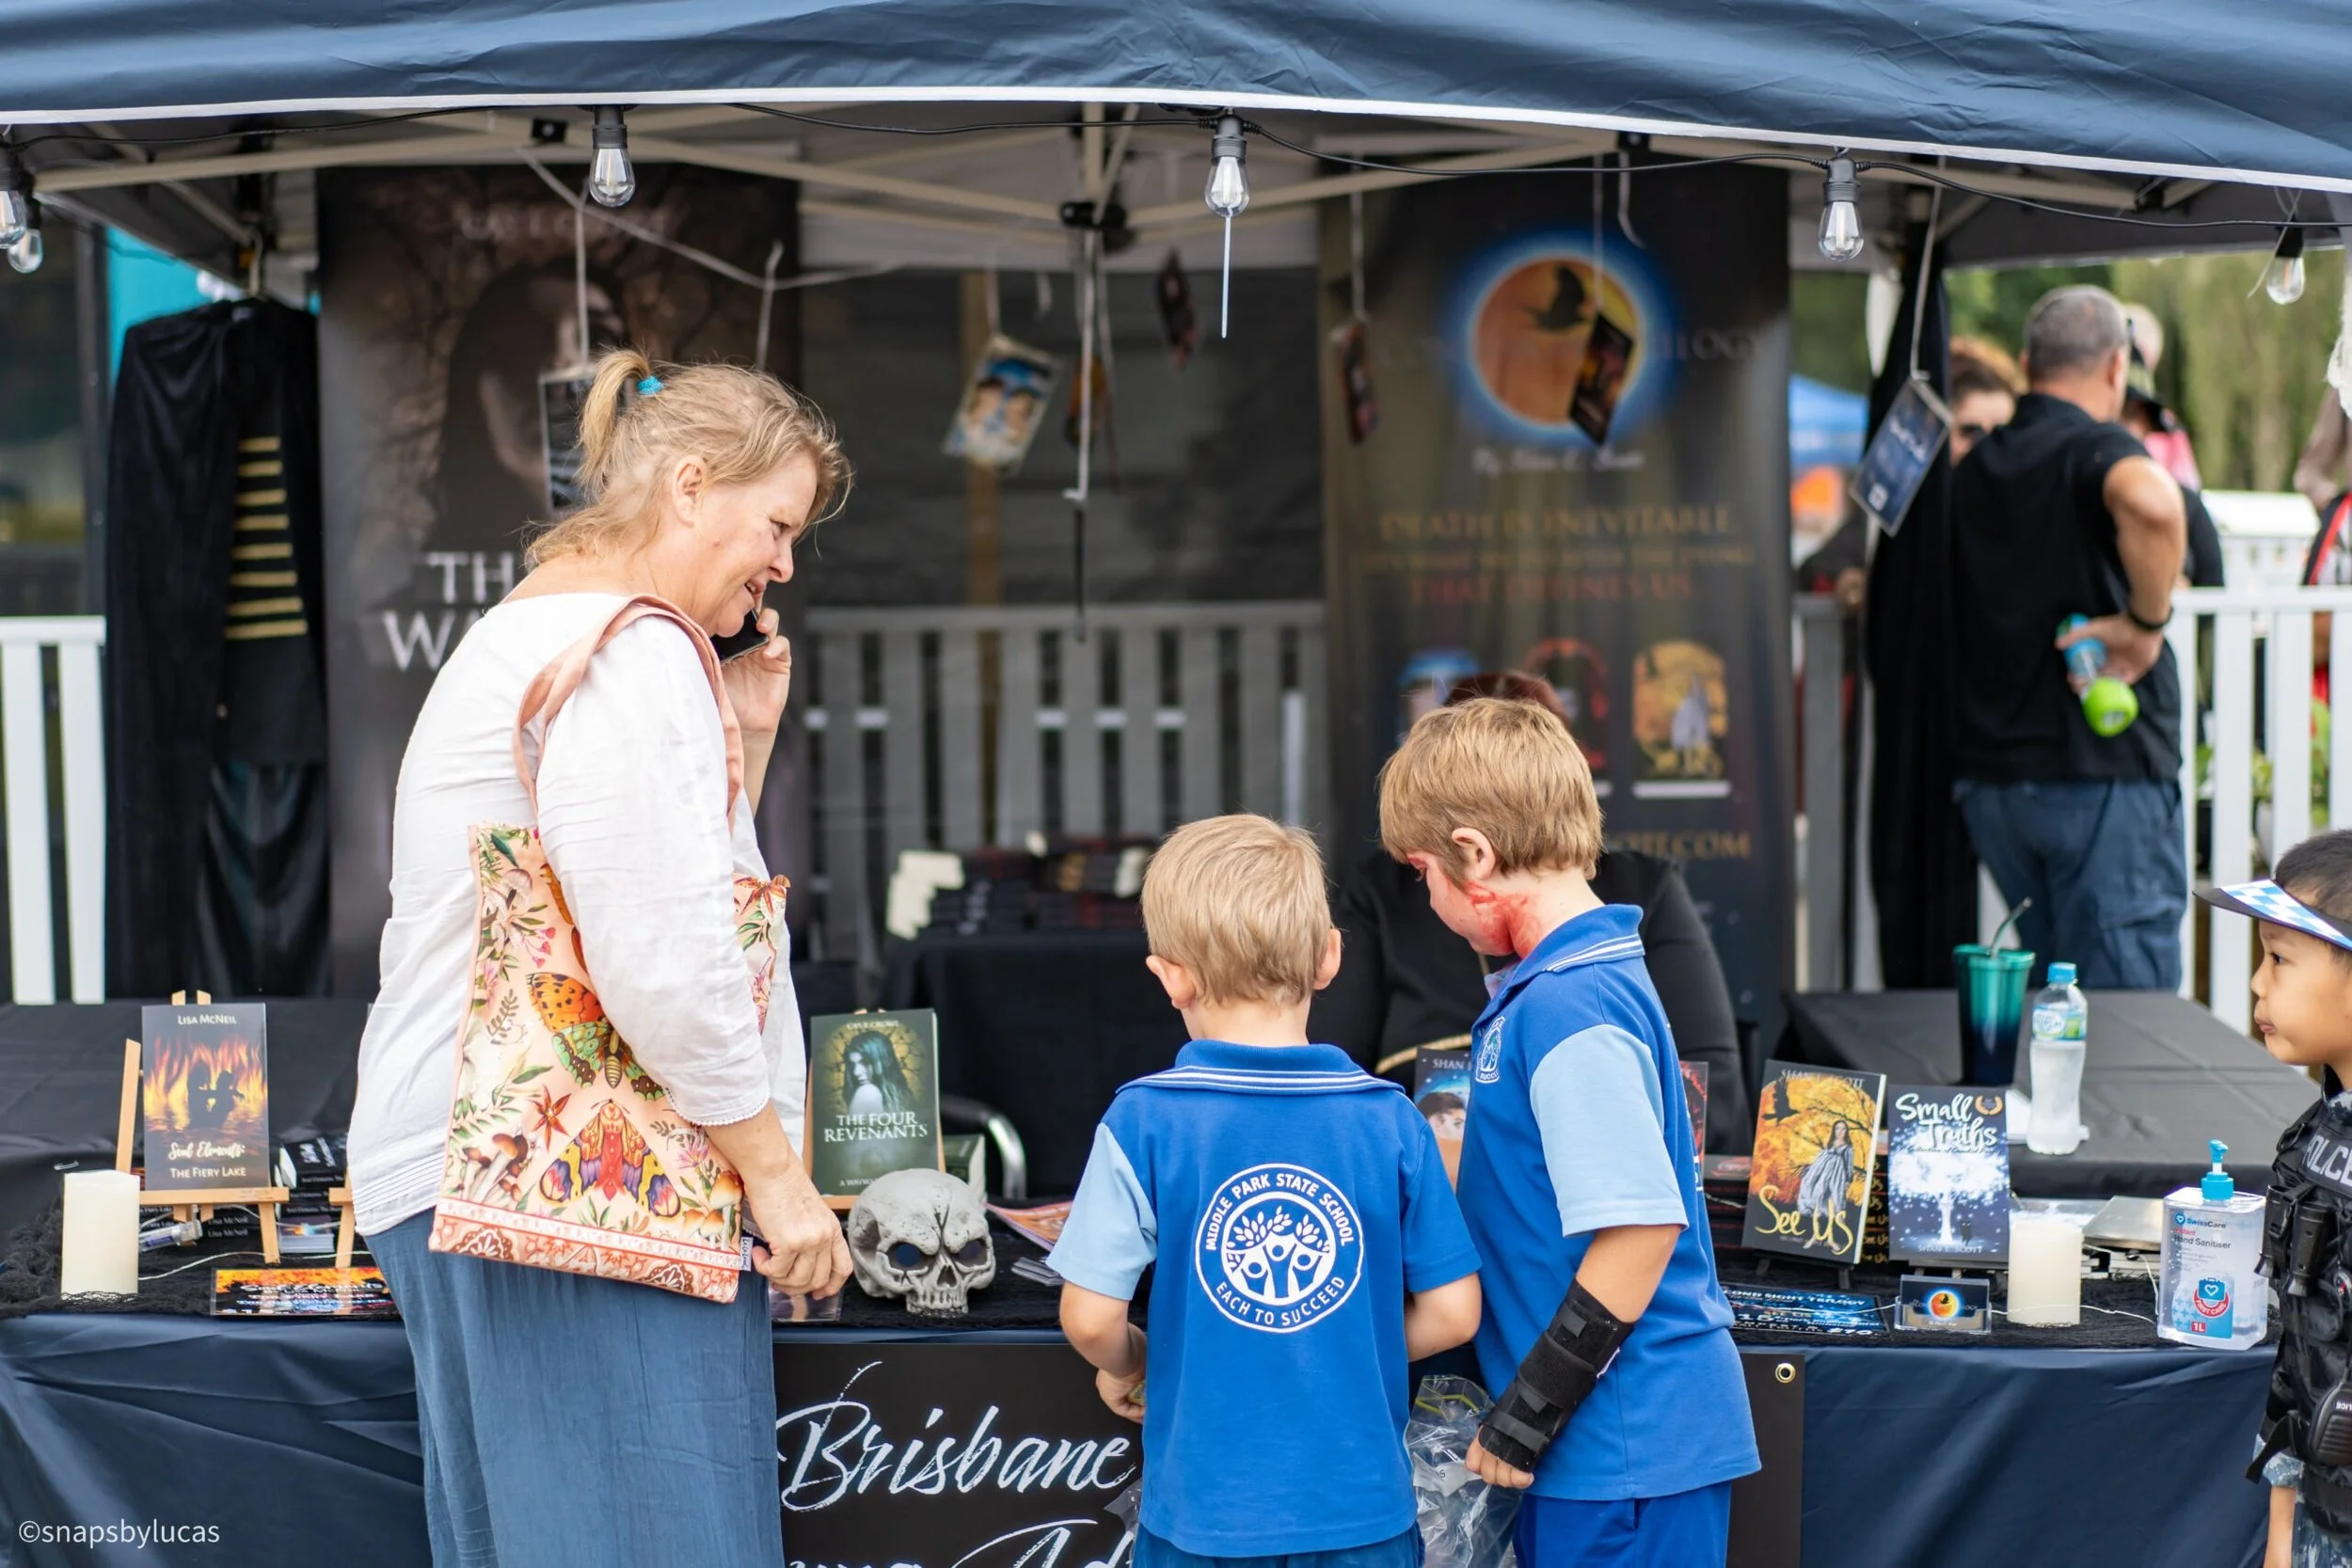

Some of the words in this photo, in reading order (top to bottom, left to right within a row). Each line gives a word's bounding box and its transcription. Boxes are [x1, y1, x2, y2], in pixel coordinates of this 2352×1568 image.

[425, 551, 514, 605] TH
[177, 1015, 198, 1025] LISA
[1432, 1058, 1464, 1069] SHAN
[1895, 1092, 1974, 1122] Small
[836, 1114, 866, 1127] THE
[867, 1111, 918, 1127] FOUR
[824, 1123, 928, 1143] REVENANTS
[1918, 1116, 1998, 1148] Truths
[169, 1167, 191, 1179] THE
[192, 1166, 220, 1178] FIERY
[221, 1166, 246, 1178] LAKE
[1205, 1196, 1232, 1251] MIDDLE
[1232, 1173, 1271, 1200] PARK
[1276, 1173, 1319, 1197] STATE
[1318, 1193, 1354, 1246] SCHOOL
[1754, 1184, 1806, 1236] See
[2186, 1217, 2227, 1229] SwissCare
[2173, 1234, 2195, 1244] Hand
[2195, 1237, 2232, 1249] Sanitiser
[1216, 1281, 1251, 1316] EACH
[1254, 1307, 1275, 1324] TO
[1280, 1275, 1345, 1326] SUCCEED
[2192, 1323, 2206, 1332] 1L
[776, 1360, 1136, 1513] Brisbane
